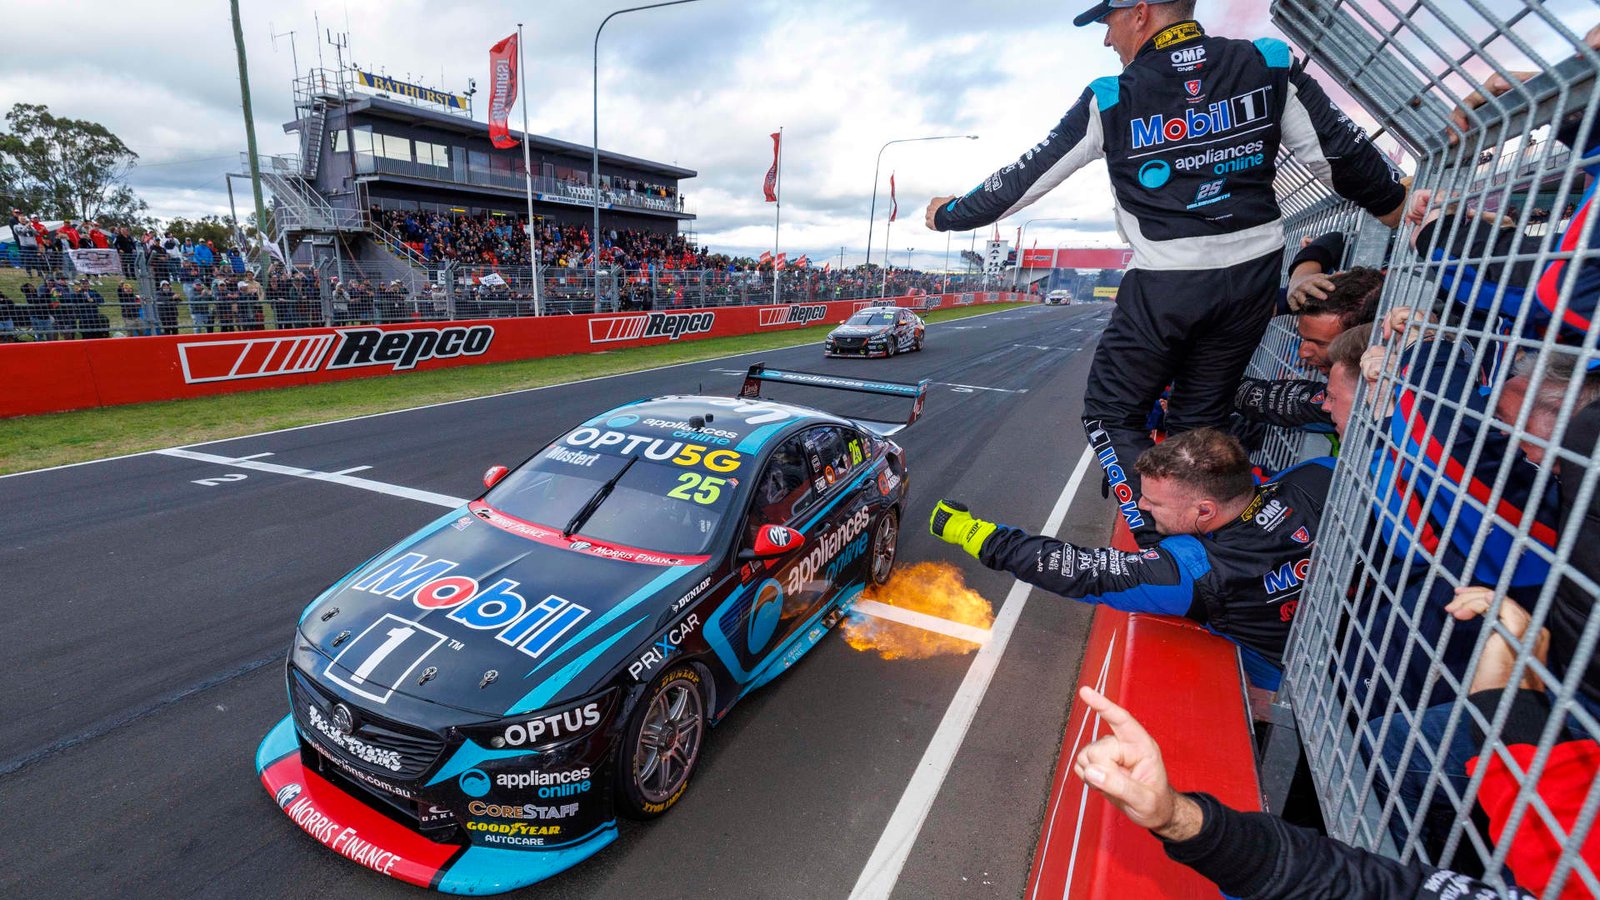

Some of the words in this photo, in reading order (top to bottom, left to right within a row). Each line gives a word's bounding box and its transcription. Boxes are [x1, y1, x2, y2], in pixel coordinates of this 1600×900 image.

[1171, 48, 1206, 63] OMP
[374, 77, 452, 108] BATHURST
[1130, 100, 1232, 149] Mobil
[1240, 94, 1256, 121] 1
[1175, 140, 1264, 170] appliances
[1214, 153, 1264, 175] online
[1197, 180, 1224, 201] 25
[642, 311, 715, 339] Repco
[786, 304, 827, 323] Repco
[326, 325, 495, 370] Repco
[783, 373, 864, 387] appliances
[672, 430, 730, 446] online
[545, 446, 601, 467] Mostert
[849, 440, 863, 465] 25
[190, 473, 248, 487] 2
[666, 472, 727, 504] 25
[1098, 446, 1145, 529] Mobil
[1255, 499, 1282, 526] OMP
[769, 526, 789, 546] MF
[592, 546, 636, 560] MORRIS
[636, 553, 685, 566] FINANCE
[787, 504, 869, 596] appliances
[824, 531, 869, 585] online
[352, 551, 592, 659] Mobil
[678, 576, 711, 608] DUNLOP
[350, 627, 416, 685] 1
[448, 639, 465, 651] TM
[628, 613, 700, 681] PRIXCAR
[661, 669, 700, 687] DUNLOP
[504, 703, 601, 746] OPTUS
[496, 767, 591, 789] appliances
[538, 780, 592, 799] online
[288, 796, 339, 844] MORRIS
[331, 827, 403, 876] FINANCE
[485, 834, 545, 846] AUTOCARE
